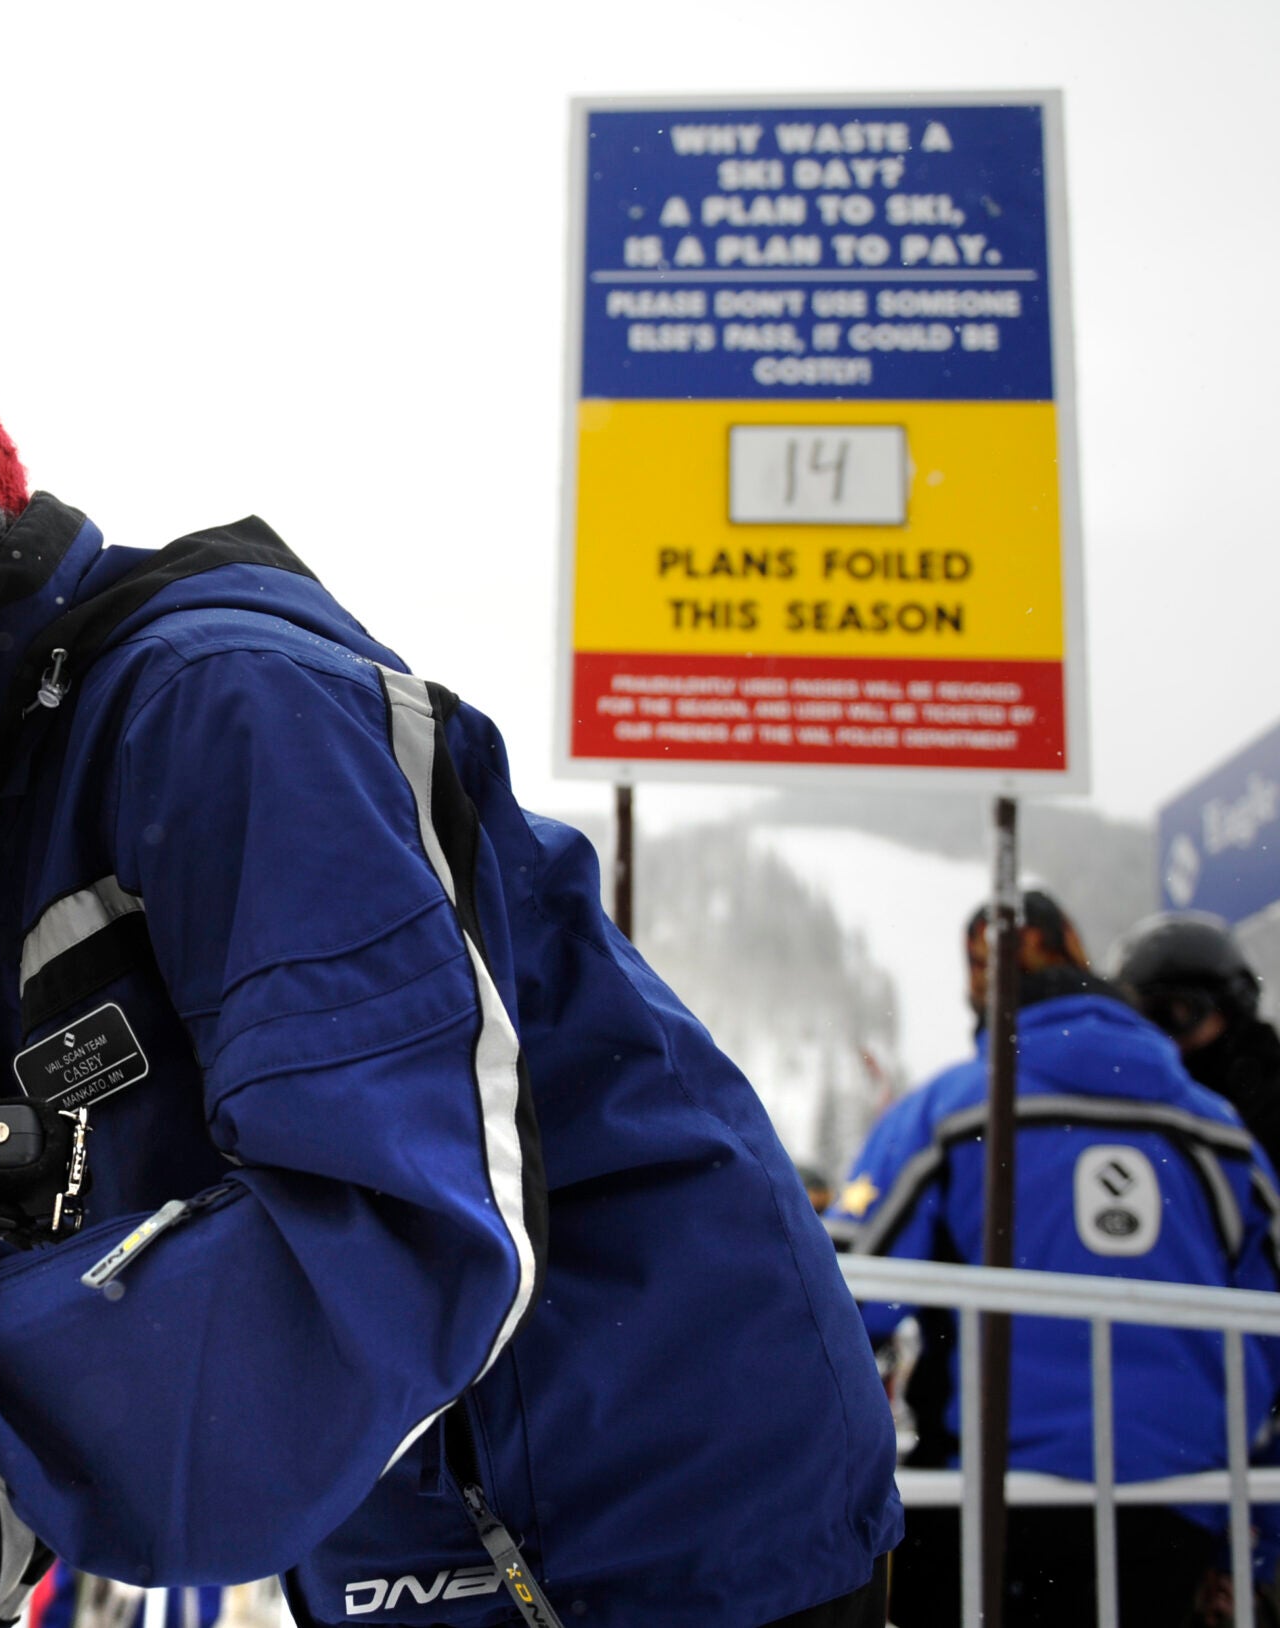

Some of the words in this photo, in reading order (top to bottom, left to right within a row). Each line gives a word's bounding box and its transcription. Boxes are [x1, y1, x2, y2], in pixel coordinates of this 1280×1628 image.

[672, 125, 762, 154] WHY
[776, 123, 909, 153] WASTE
[922, 123, 951, 151] A
[719, 160, 783, 190] SKI
[794, 159, 904, 189] DAY?
[661, 197, 690, 226] A
[702, 196, 806, 225] PLAN
[818, 195, 874, 225] TO
[886, 195, 965, 228] SKI,
[625, 236, 662, 266] IS
[675, 236, 704, 265] A
[717, 236, 821, 265] PLAN
[833, 235, 890, 265] TO
[901, 235, 1001, 265] PAY.
[607, 291, 706, 317] PLEASE
[715, 290, 805, 317] DON'T
[812, 290, 867, 317] USE
[878, 290, 1020, 317] SOMEONE
[629, 324, 715, 351] ELSE'S
[724, 324, 805, 354] PASS,
[813, 324, 841, 349] IT
[848, 324, 954, 351] COULD
[962, 324, 999, 351] BE
[784, 439, 850, 506] 14
[659, 548, 797, 580] PLANS
[823, 549, 973, 583] FOILED
[670, 598, 759, 632] THIS
[787, 601, 964, 634] SEASON
[45, 1060, 63, 1075] VAIL
[63, 1046, 87, 1065] SCAN
[84, 1034, 108, 1053] TEAM
[63, 1053, 104, 1084] CASEY
[62, 1079, 110, 1108] MANKATO,
[108, 1069, 125, 1085] MN
